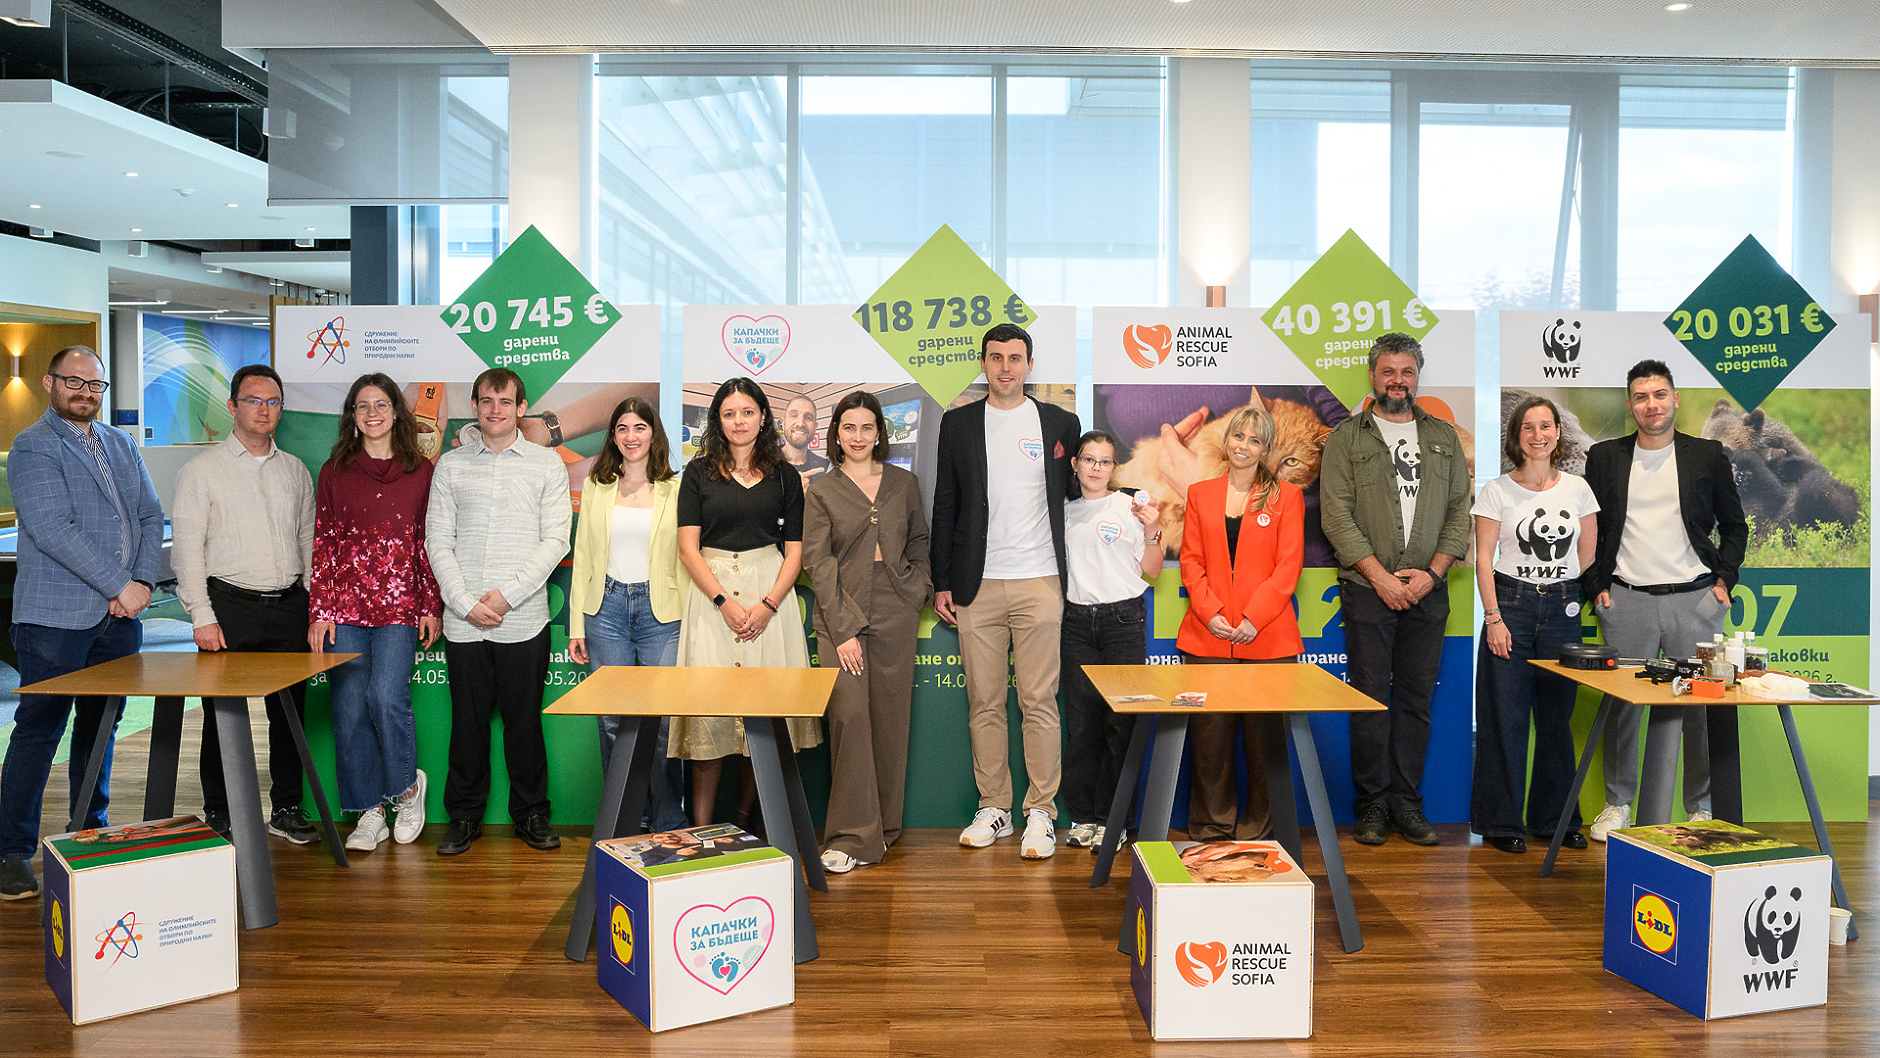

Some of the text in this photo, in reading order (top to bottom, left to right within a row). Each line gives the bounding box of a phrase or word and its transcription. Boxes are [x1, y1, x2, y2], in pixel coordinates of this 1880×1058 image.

[450, 293, 609, 334] 20 745 €
[856, 293, 1029, 334] 118 738 €
[1272, 297, 1427, 336] 40 391 €
[1672, 302, 1824, 341] 20 031 €
[733, 328, 779, 336] КАПАЧКИ
[1176, 326, 1233, 338] ANIMAL
[503, 335, 559, 351] дарени
[744, 337, 780, 345] БЪДЕЩЕ
[917, 336, 974, 351] дарени
[1176, 341, 1228, 353] RESCUE
[494, 348, 571, 367] средства
[1724, 343, 1777, 358] дарени
[1176, 356, 1217, 367] SOFIA
[1315, 355, 1369, 370] средст
[1715, 356, 1788, 374] средства
[1543, 366, 1581, 378] WWF
[1516, 565, 1568, 578] WWF
[1767, 648, 1830, 663] аковки
[158, 915, 194, 926] СДРУЖЕНИЕ
[168, 918, 217, 931] ОЛИМПИЙСКИТЕ
[691, 916, 758, 939] КАПАЧКИ
[159, 932, 183, 941] ОТБОРИ
[159, 933, 213, 948] ПРИРОДНИ НАУКИ
[690, 930, 759, 951] ЗА БЪДЕЩЕ
[1232, 943, 1292, 955] ANIMAL
[1232, 958, 1287, 970] RESCUE
[1232, 973, 1275, 985] SOFIA
[1743, 968, 1798, 994] WWF
